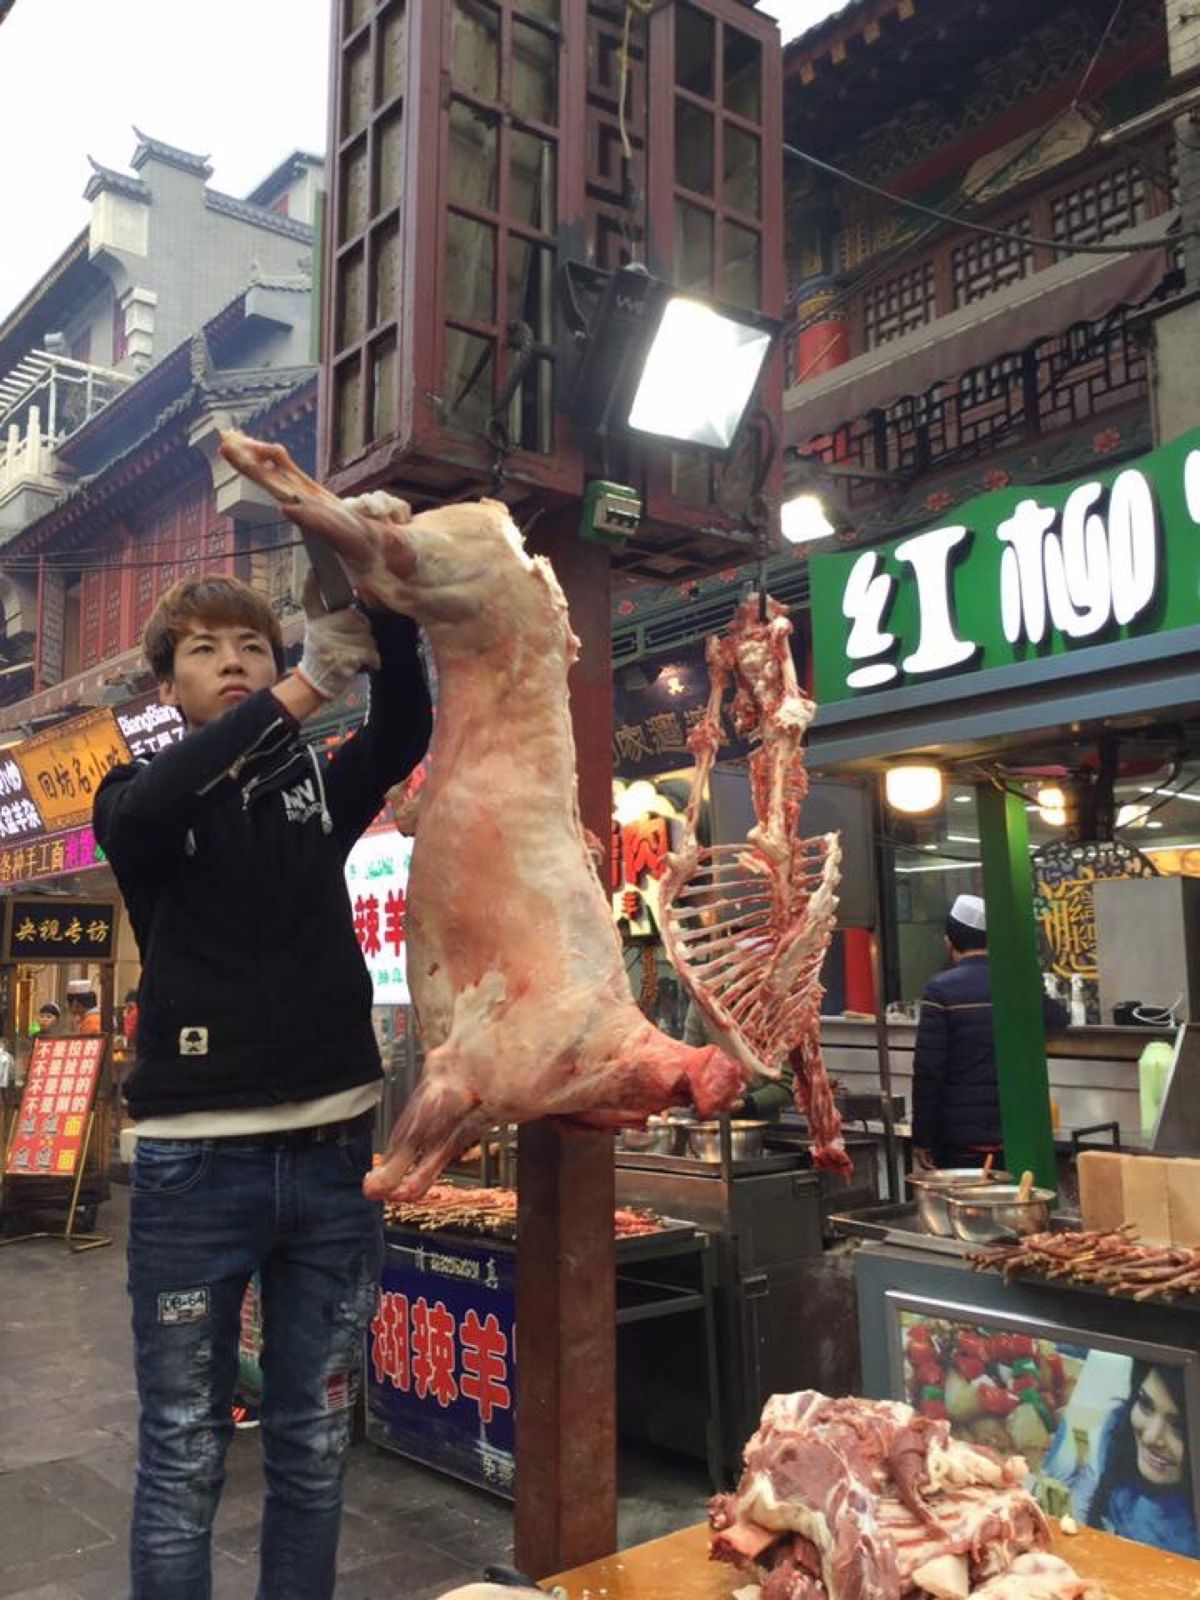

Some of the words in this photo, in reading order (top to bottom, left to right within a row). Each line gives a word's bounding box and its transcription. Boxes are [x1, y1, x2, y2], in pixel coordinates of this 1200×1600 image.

[842, 449, 1200, 689] 红柳
[15, 916, 109, 945] 央视专访
